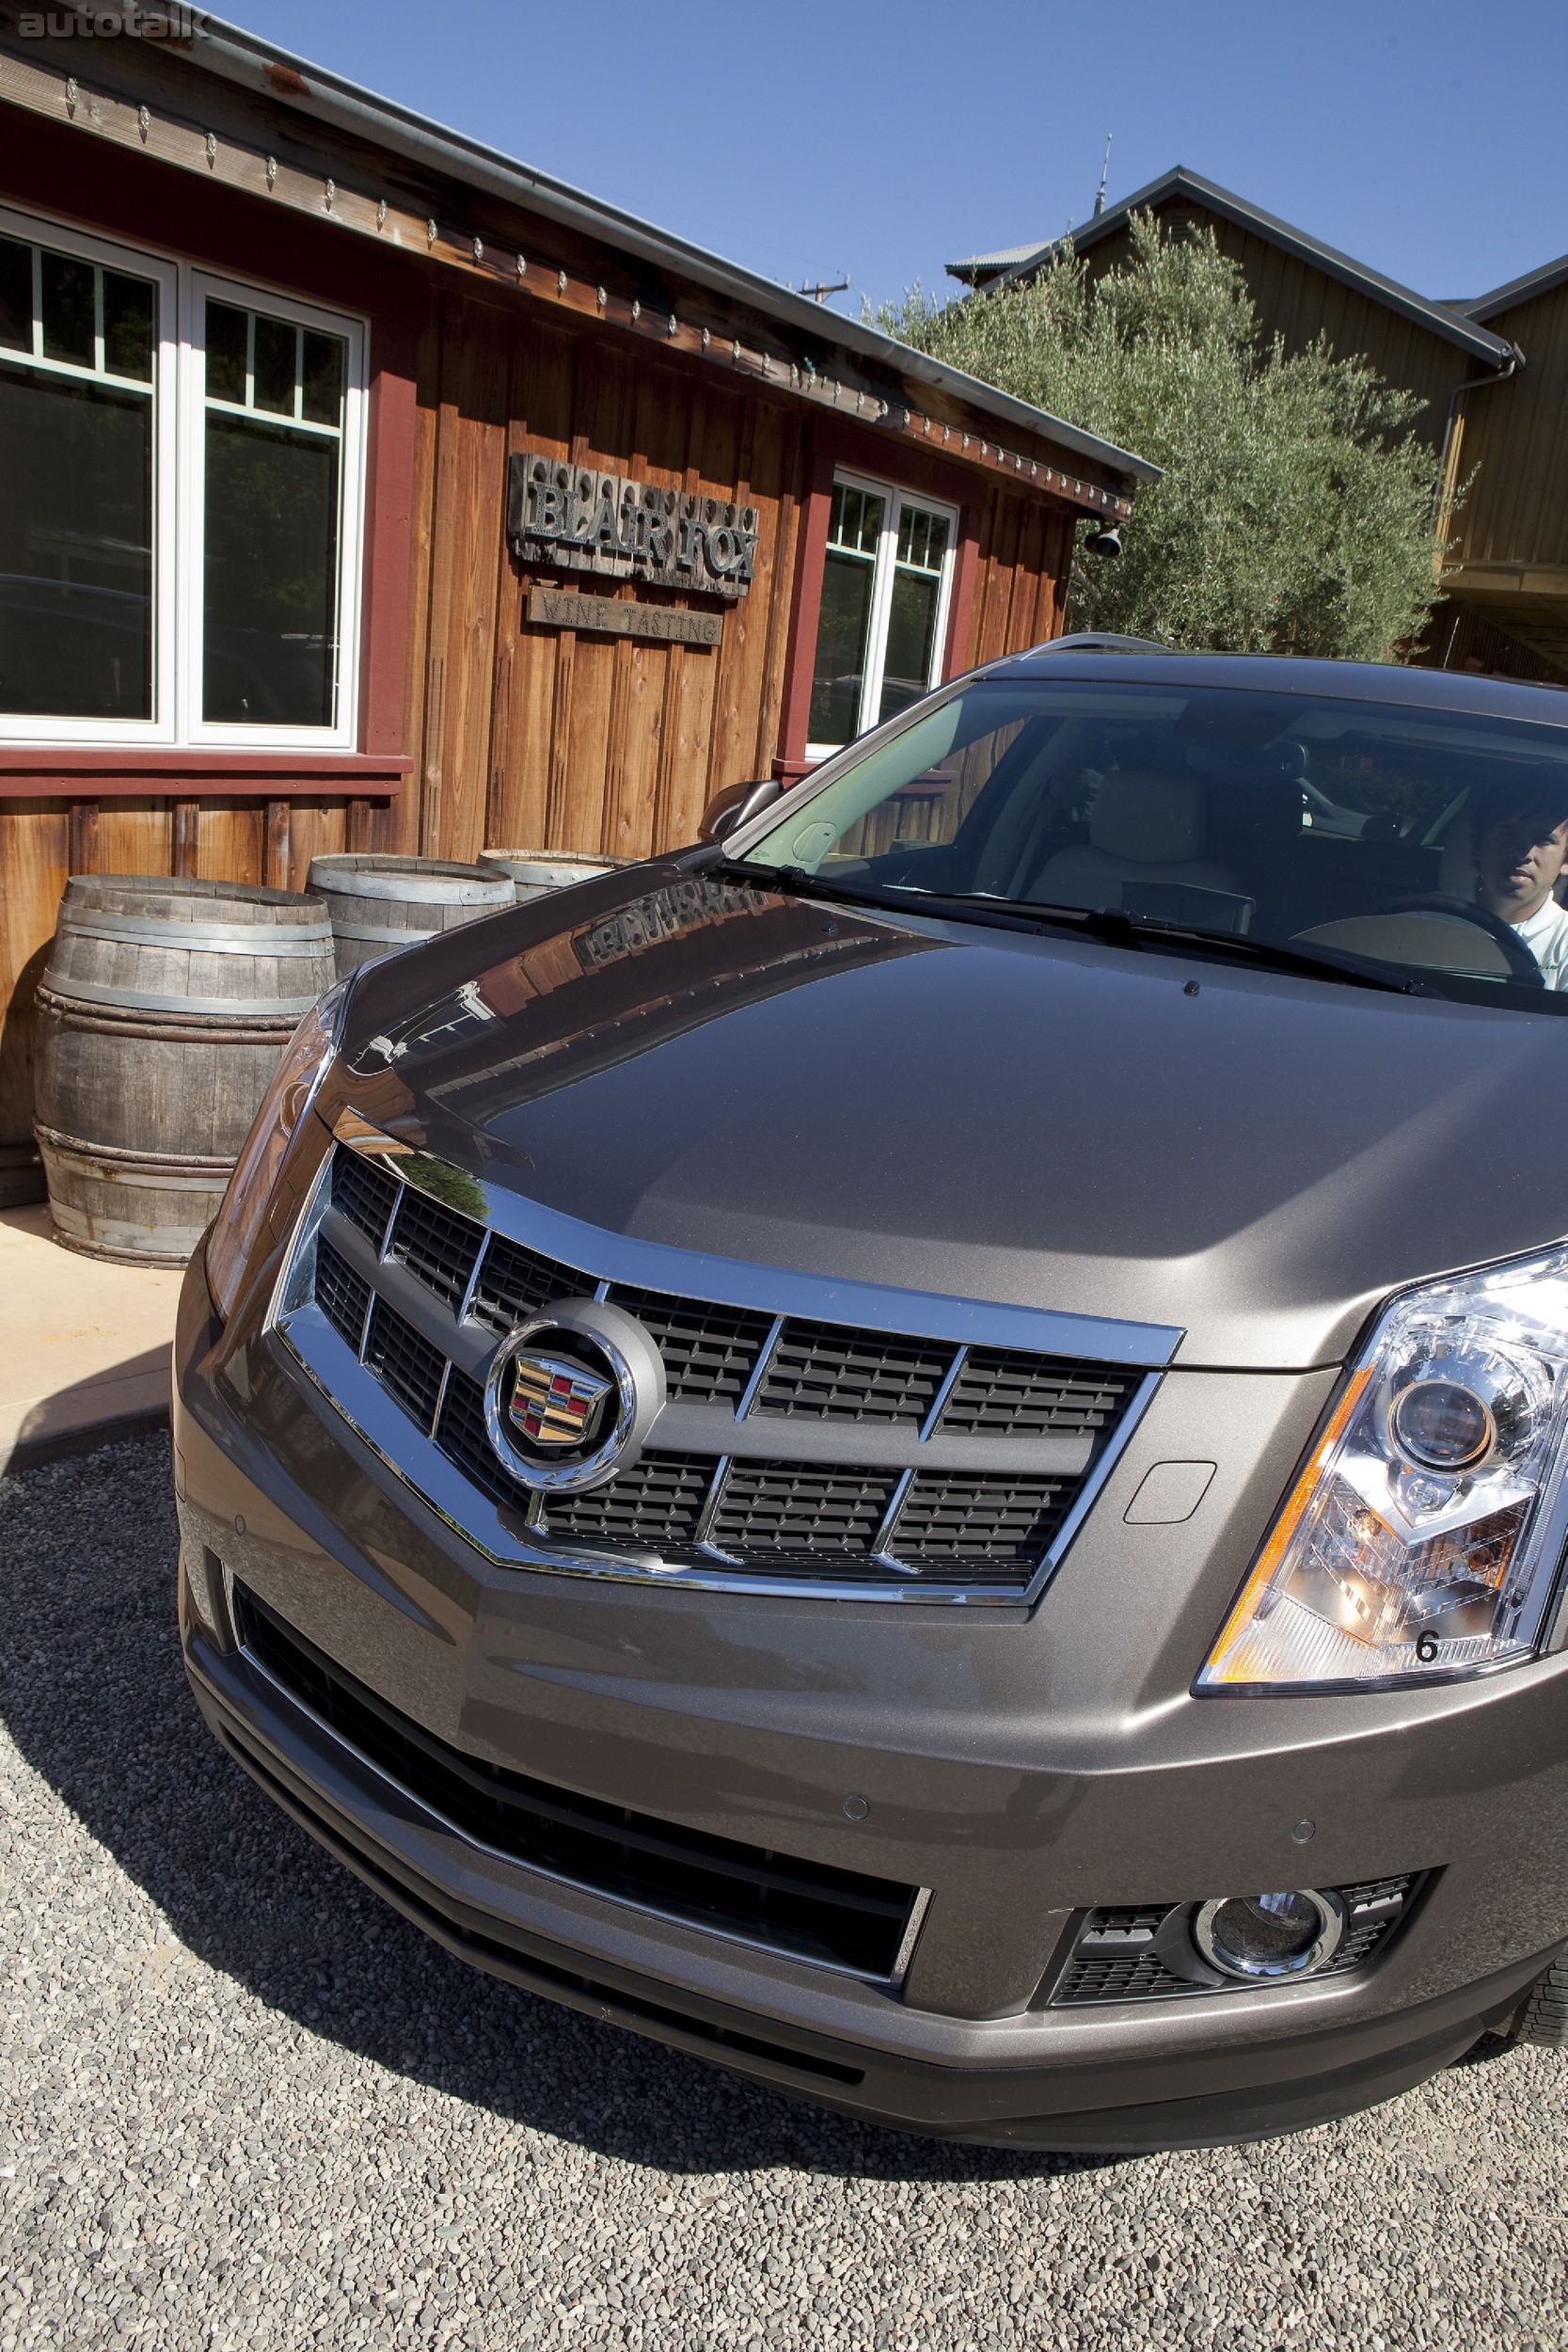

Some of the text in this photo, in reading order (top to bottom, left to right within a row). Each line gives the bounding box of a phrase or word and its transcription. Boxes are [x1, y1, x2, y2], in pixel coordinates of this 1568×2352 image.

[526, 481, 760, 579] BLAIR FOX
[543, 595, 717, 642] WINE TASTING
[1417, 1629, 1439, 1662] 6
